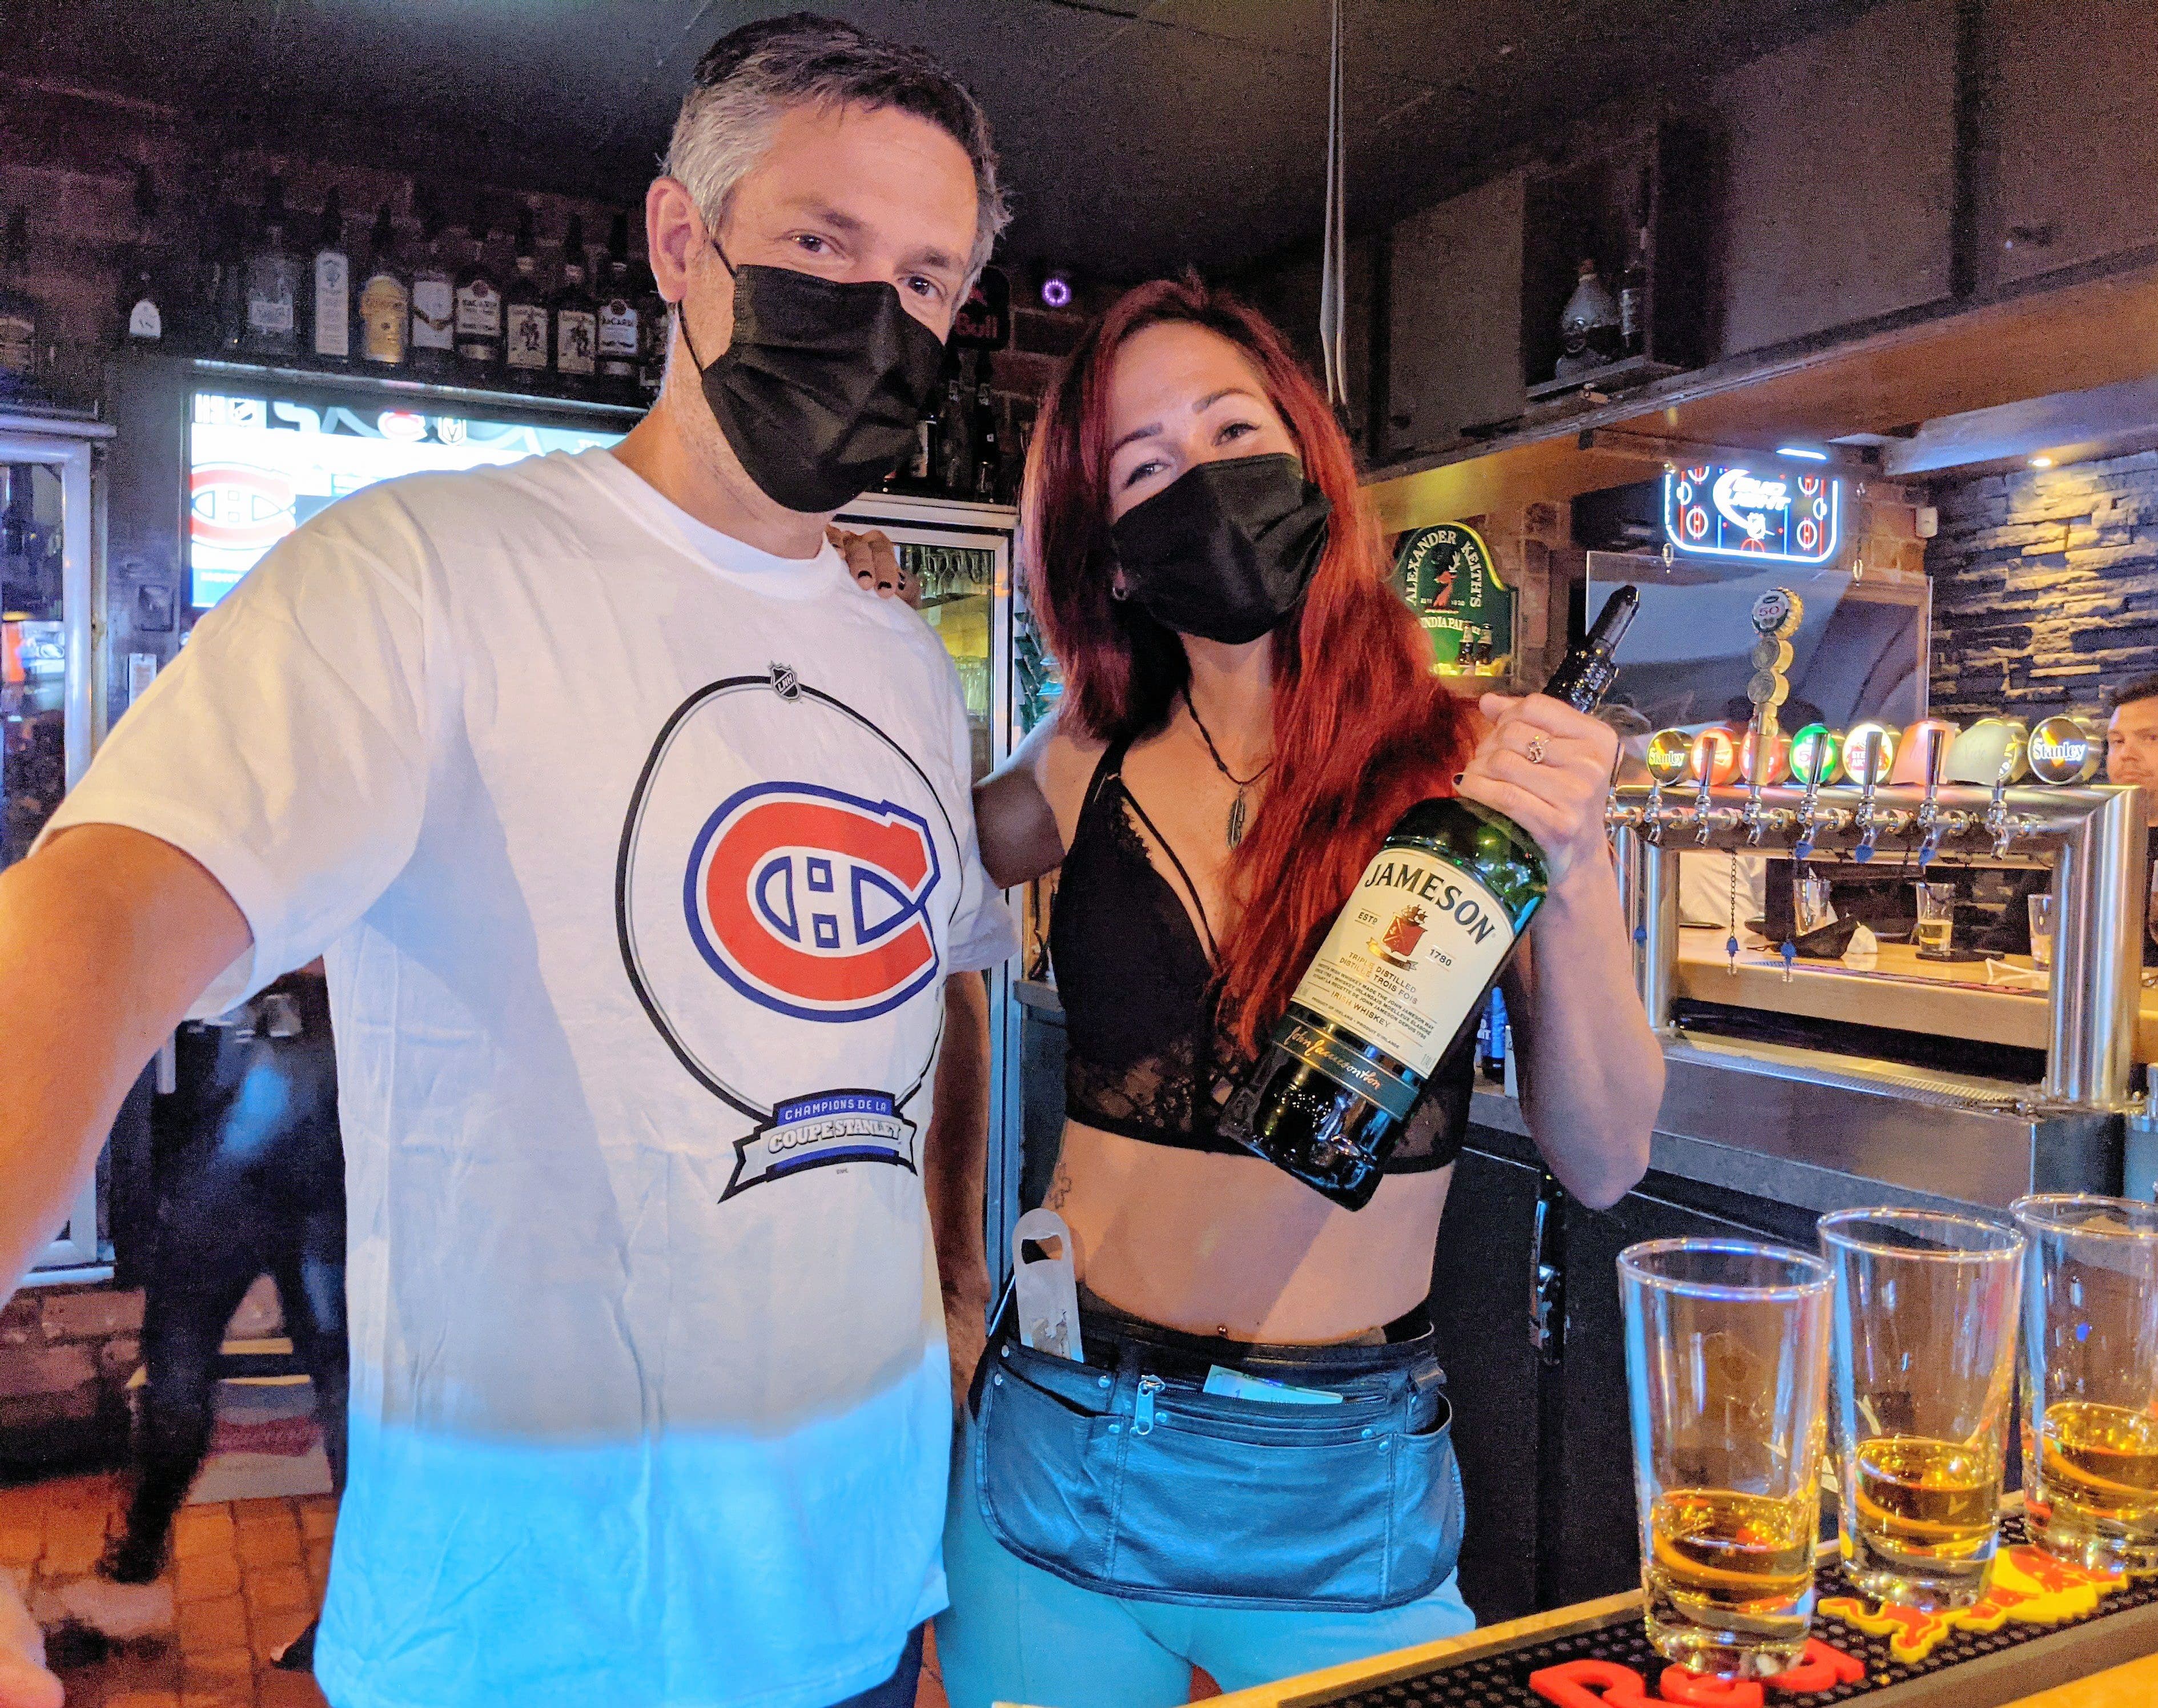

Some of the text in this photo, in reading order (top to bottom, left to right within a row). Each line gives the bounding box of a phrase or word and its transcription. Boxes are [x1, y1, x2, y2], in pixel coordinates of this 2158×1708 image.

[1405, 530, 1482, 607] ALEXANDER KEITH'S
[1421, 617, 1448, 628] INDIA
[1448, 618, 1465, 631] PAL
[1648, 747, 1685, 767] Stanley
[2033, 737, 2085, 761] Stanley
[1364, 862, 1496, 946] JAMESON
[1348, 950, 1375, 970] TRIPLE
[1375, 965, 1417, 993] DISTILLED
[1429, 948, 1452, 967] 1780
[1361, 984, 1376, 995] MADE
[1377, 992, 1388, 1001] THE
[1388, 999, 1402, 1010] JOHN
[1401, 1007, 1425, 1023] JAMESON
[1372, 974, 1397, 992] TROIS
[1397, 988, 1418, 1004] FOIS
[1331, 990, 1391, 1028] IRISH WHISKEY
[1359, 996, 1373, 1006] JOHN
[1373, 1004, 1399, 1021] JAMESON
[1397, 1019, 1417, 1033] DEPUIS
[785, 1099, 886, 1121] CHAMPIONS DE LA
